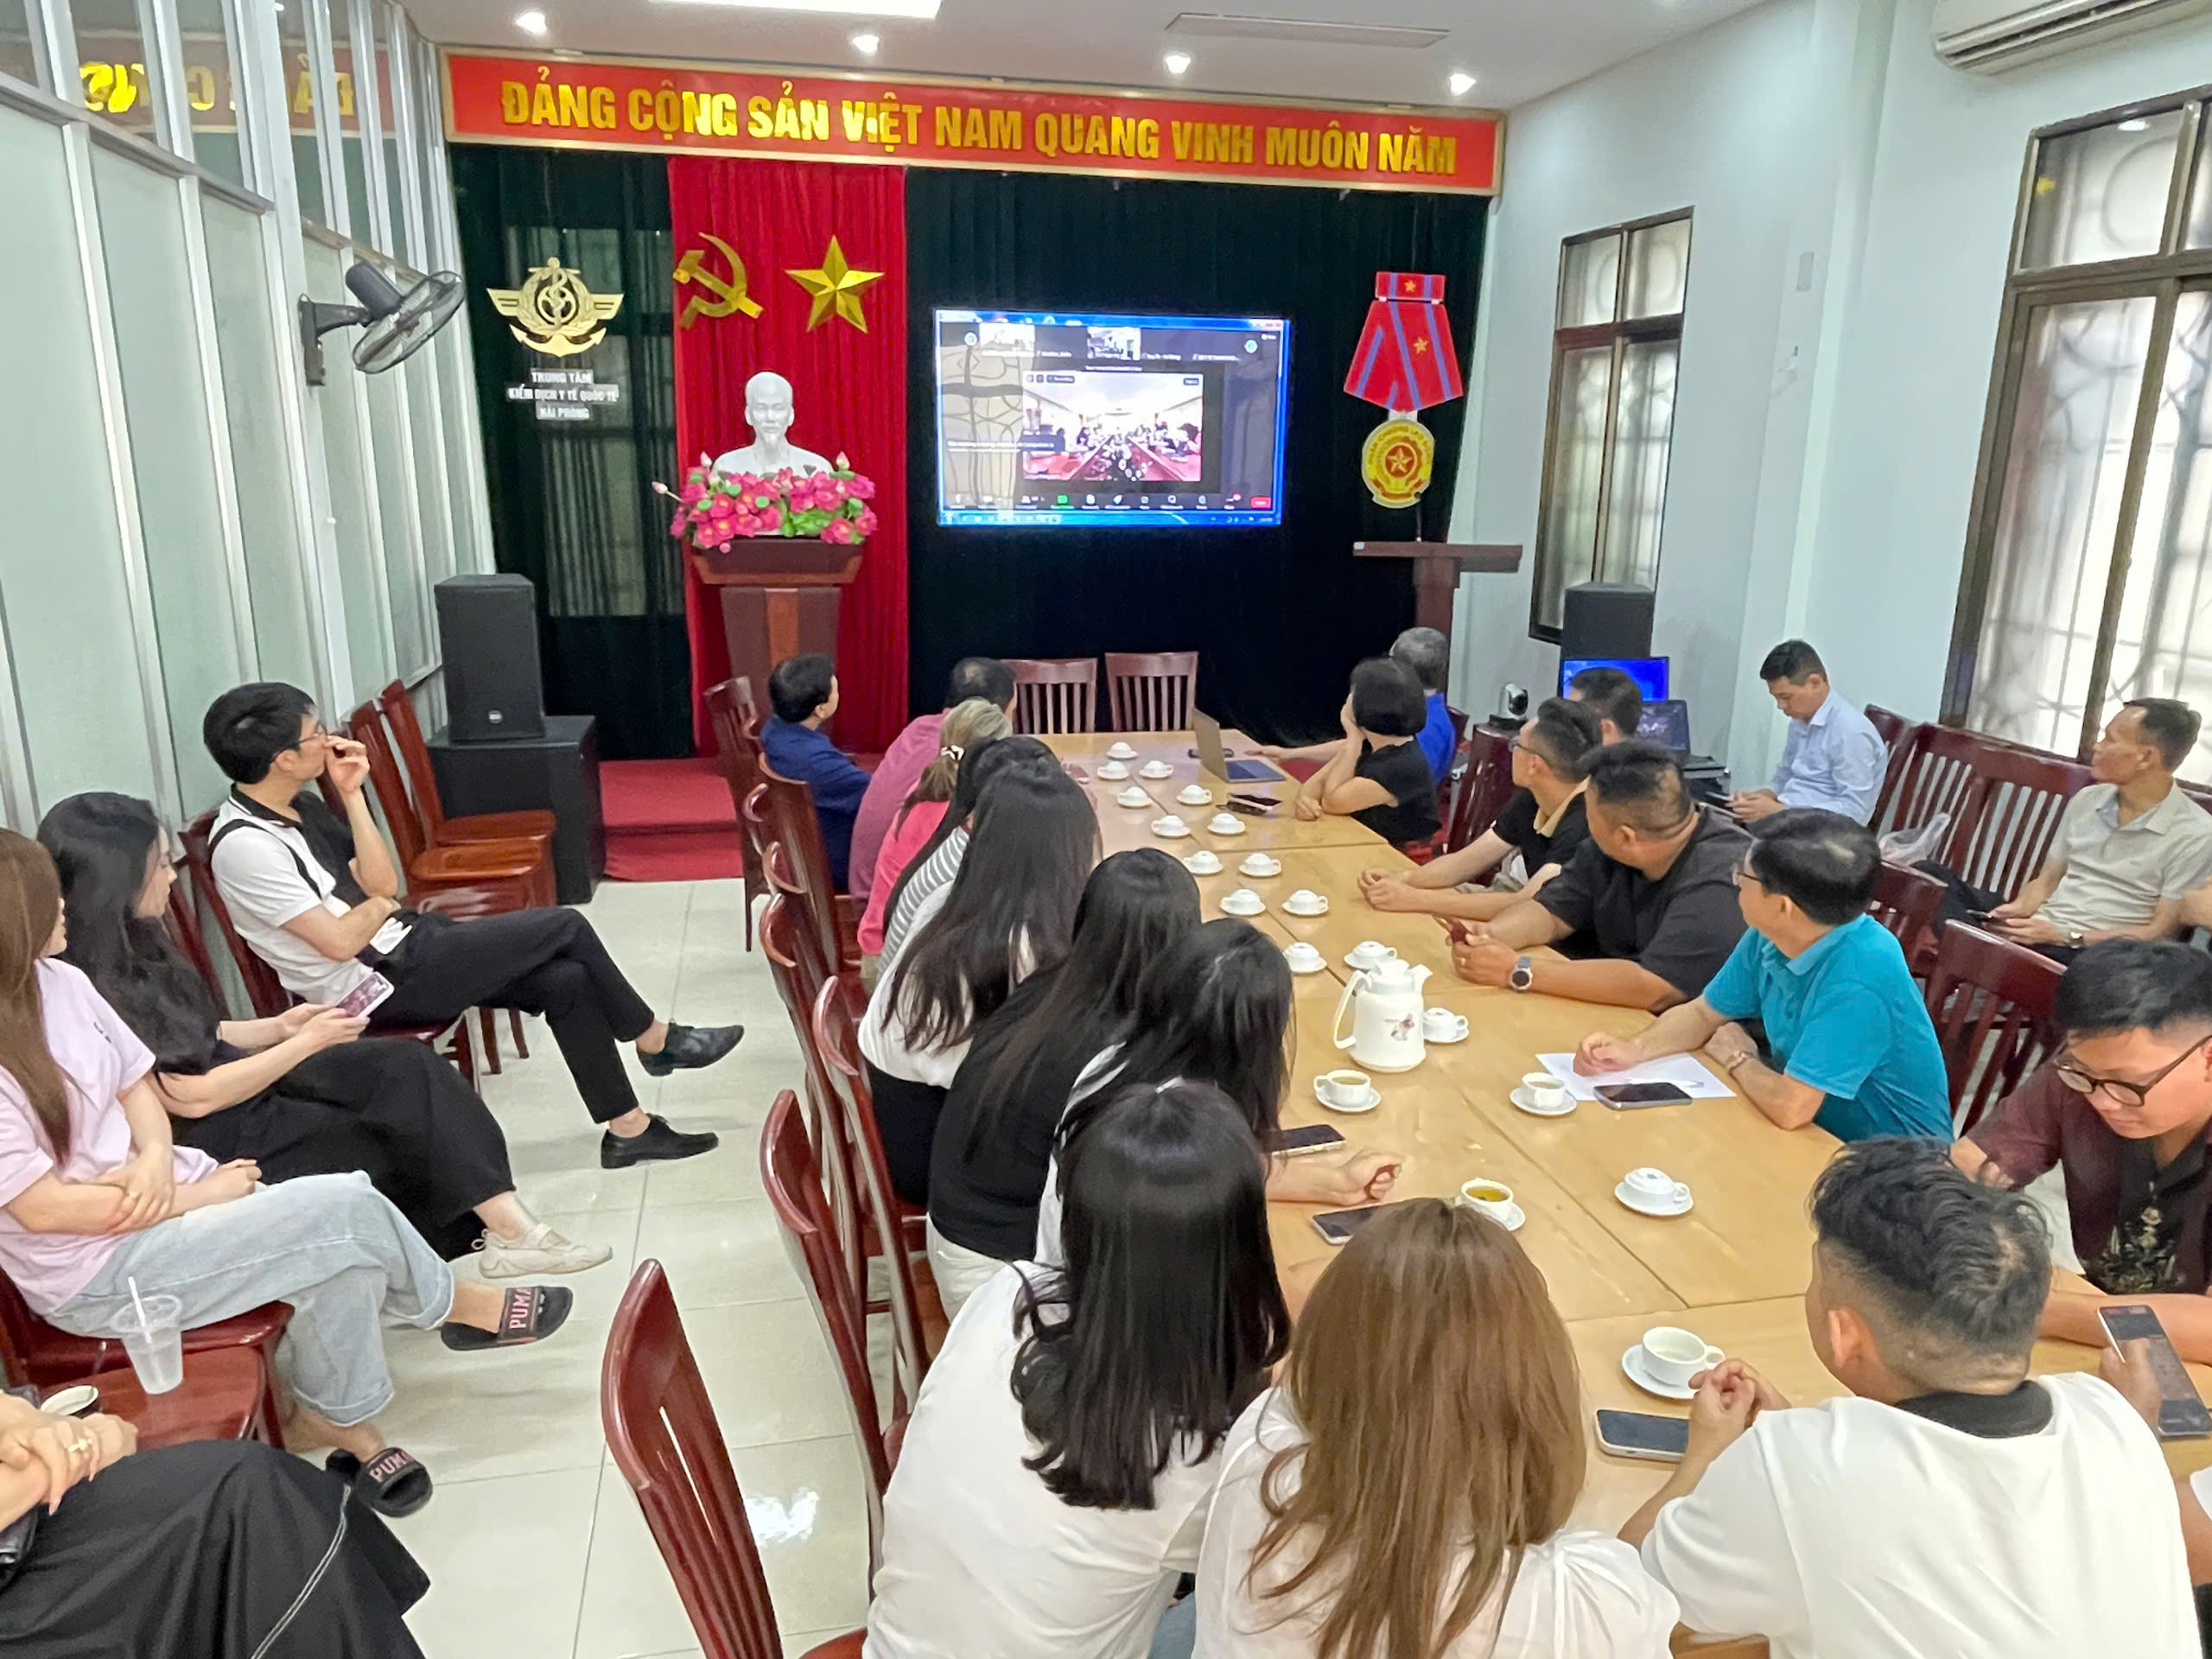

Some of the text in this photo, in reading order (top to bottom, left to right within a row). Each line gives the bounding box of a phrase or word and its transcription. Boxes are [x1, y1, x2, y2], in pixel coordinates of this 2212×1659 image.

[501, 65, 1457, 175] ĐẢNG CỘNG SẢN VIỆT NAM QUANG VINH MUÔN NĂM
